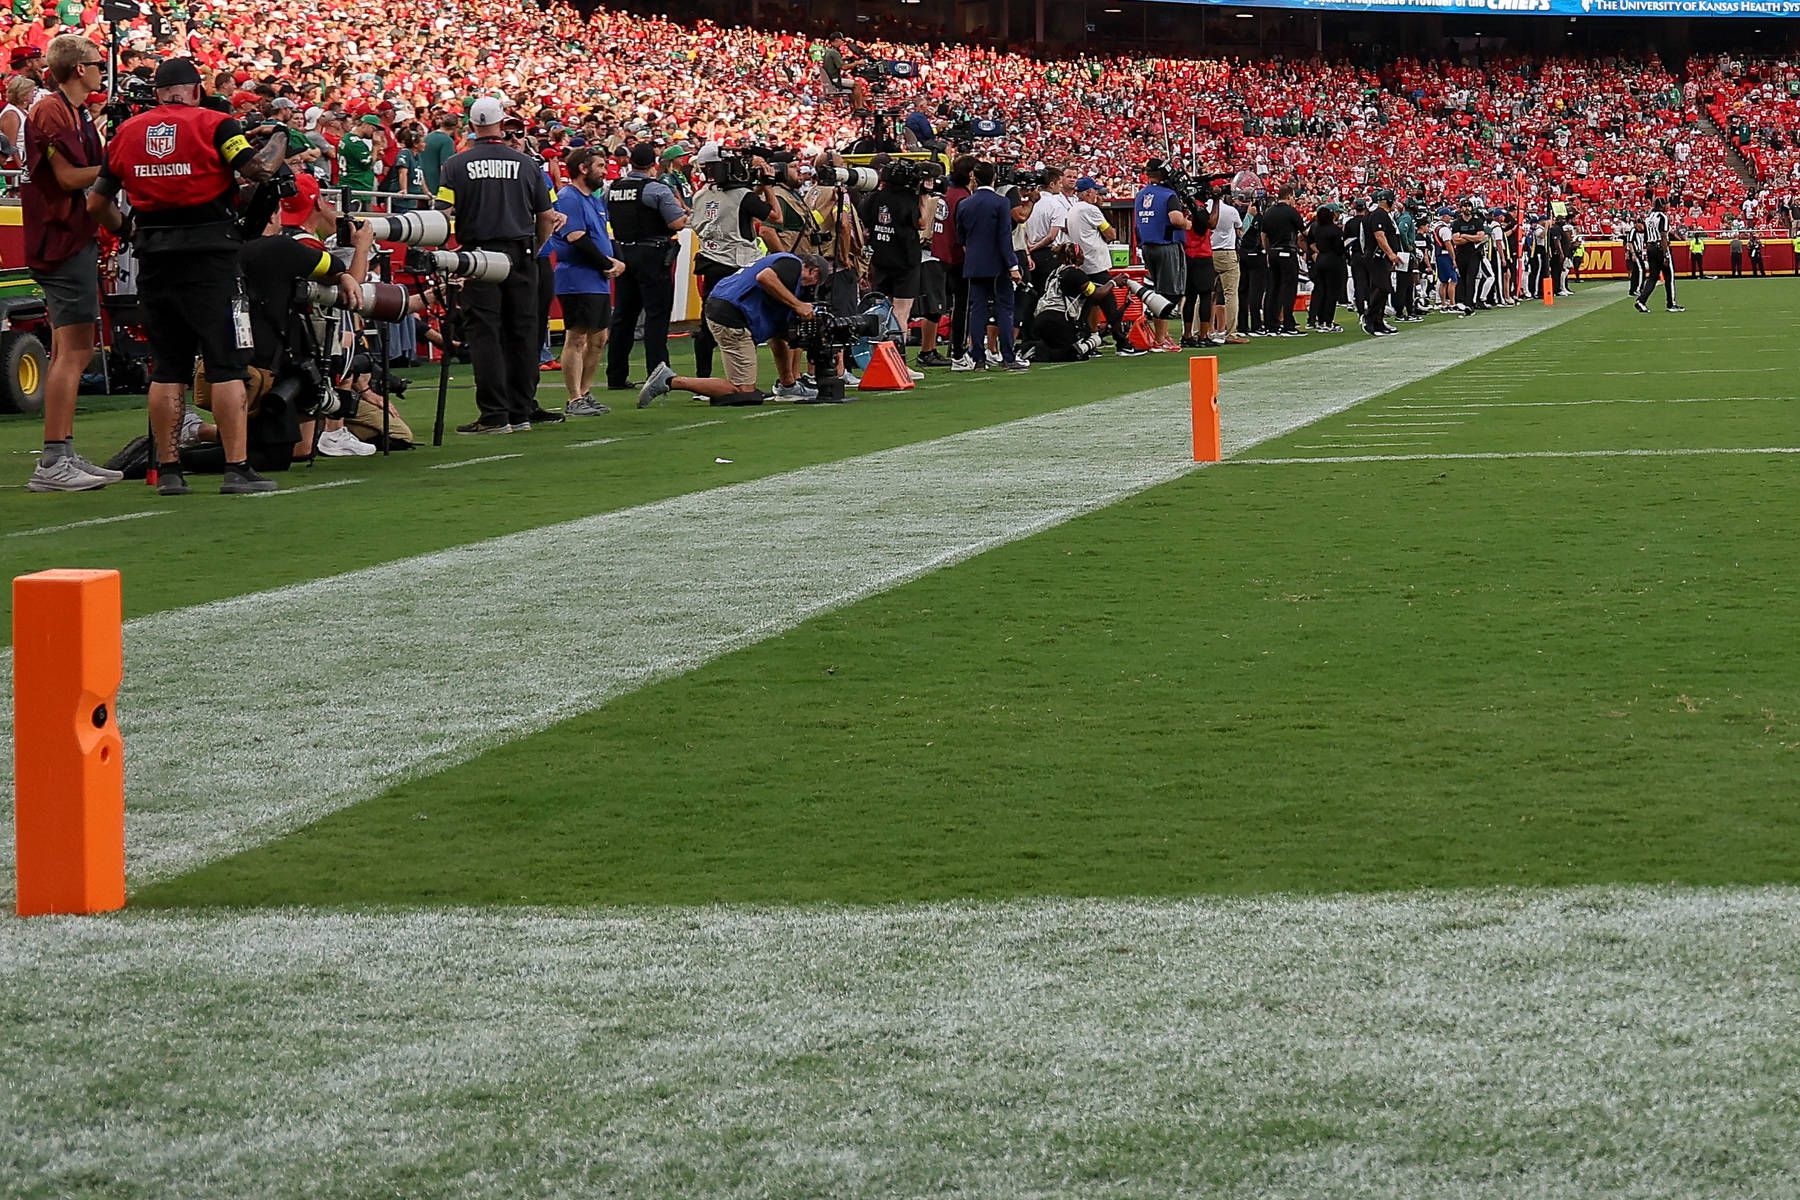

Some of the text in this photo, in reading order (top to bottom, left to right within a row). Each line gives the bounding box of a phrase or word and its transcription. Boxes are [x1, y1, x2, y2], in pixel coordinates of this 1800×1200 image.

[1596, 0, 1618, 10] THE
[1620, 0, 1682, 11] UNIVERSITY
[1682, 1, 1697, 11] OF
[1699, 0, 1738, 12] KANSAS
[1741, 1, 1780, 12] HEALTH
[150, 139, 171, 150] NFL
[134, 163, 191, 177] TELEVISION
[466, 160, 520, 179] SECURITY
[610, 189, 637, 200] POLICE
[874, 225, 895, 234] MEDIA
[877, 234, 890, 242] 045
